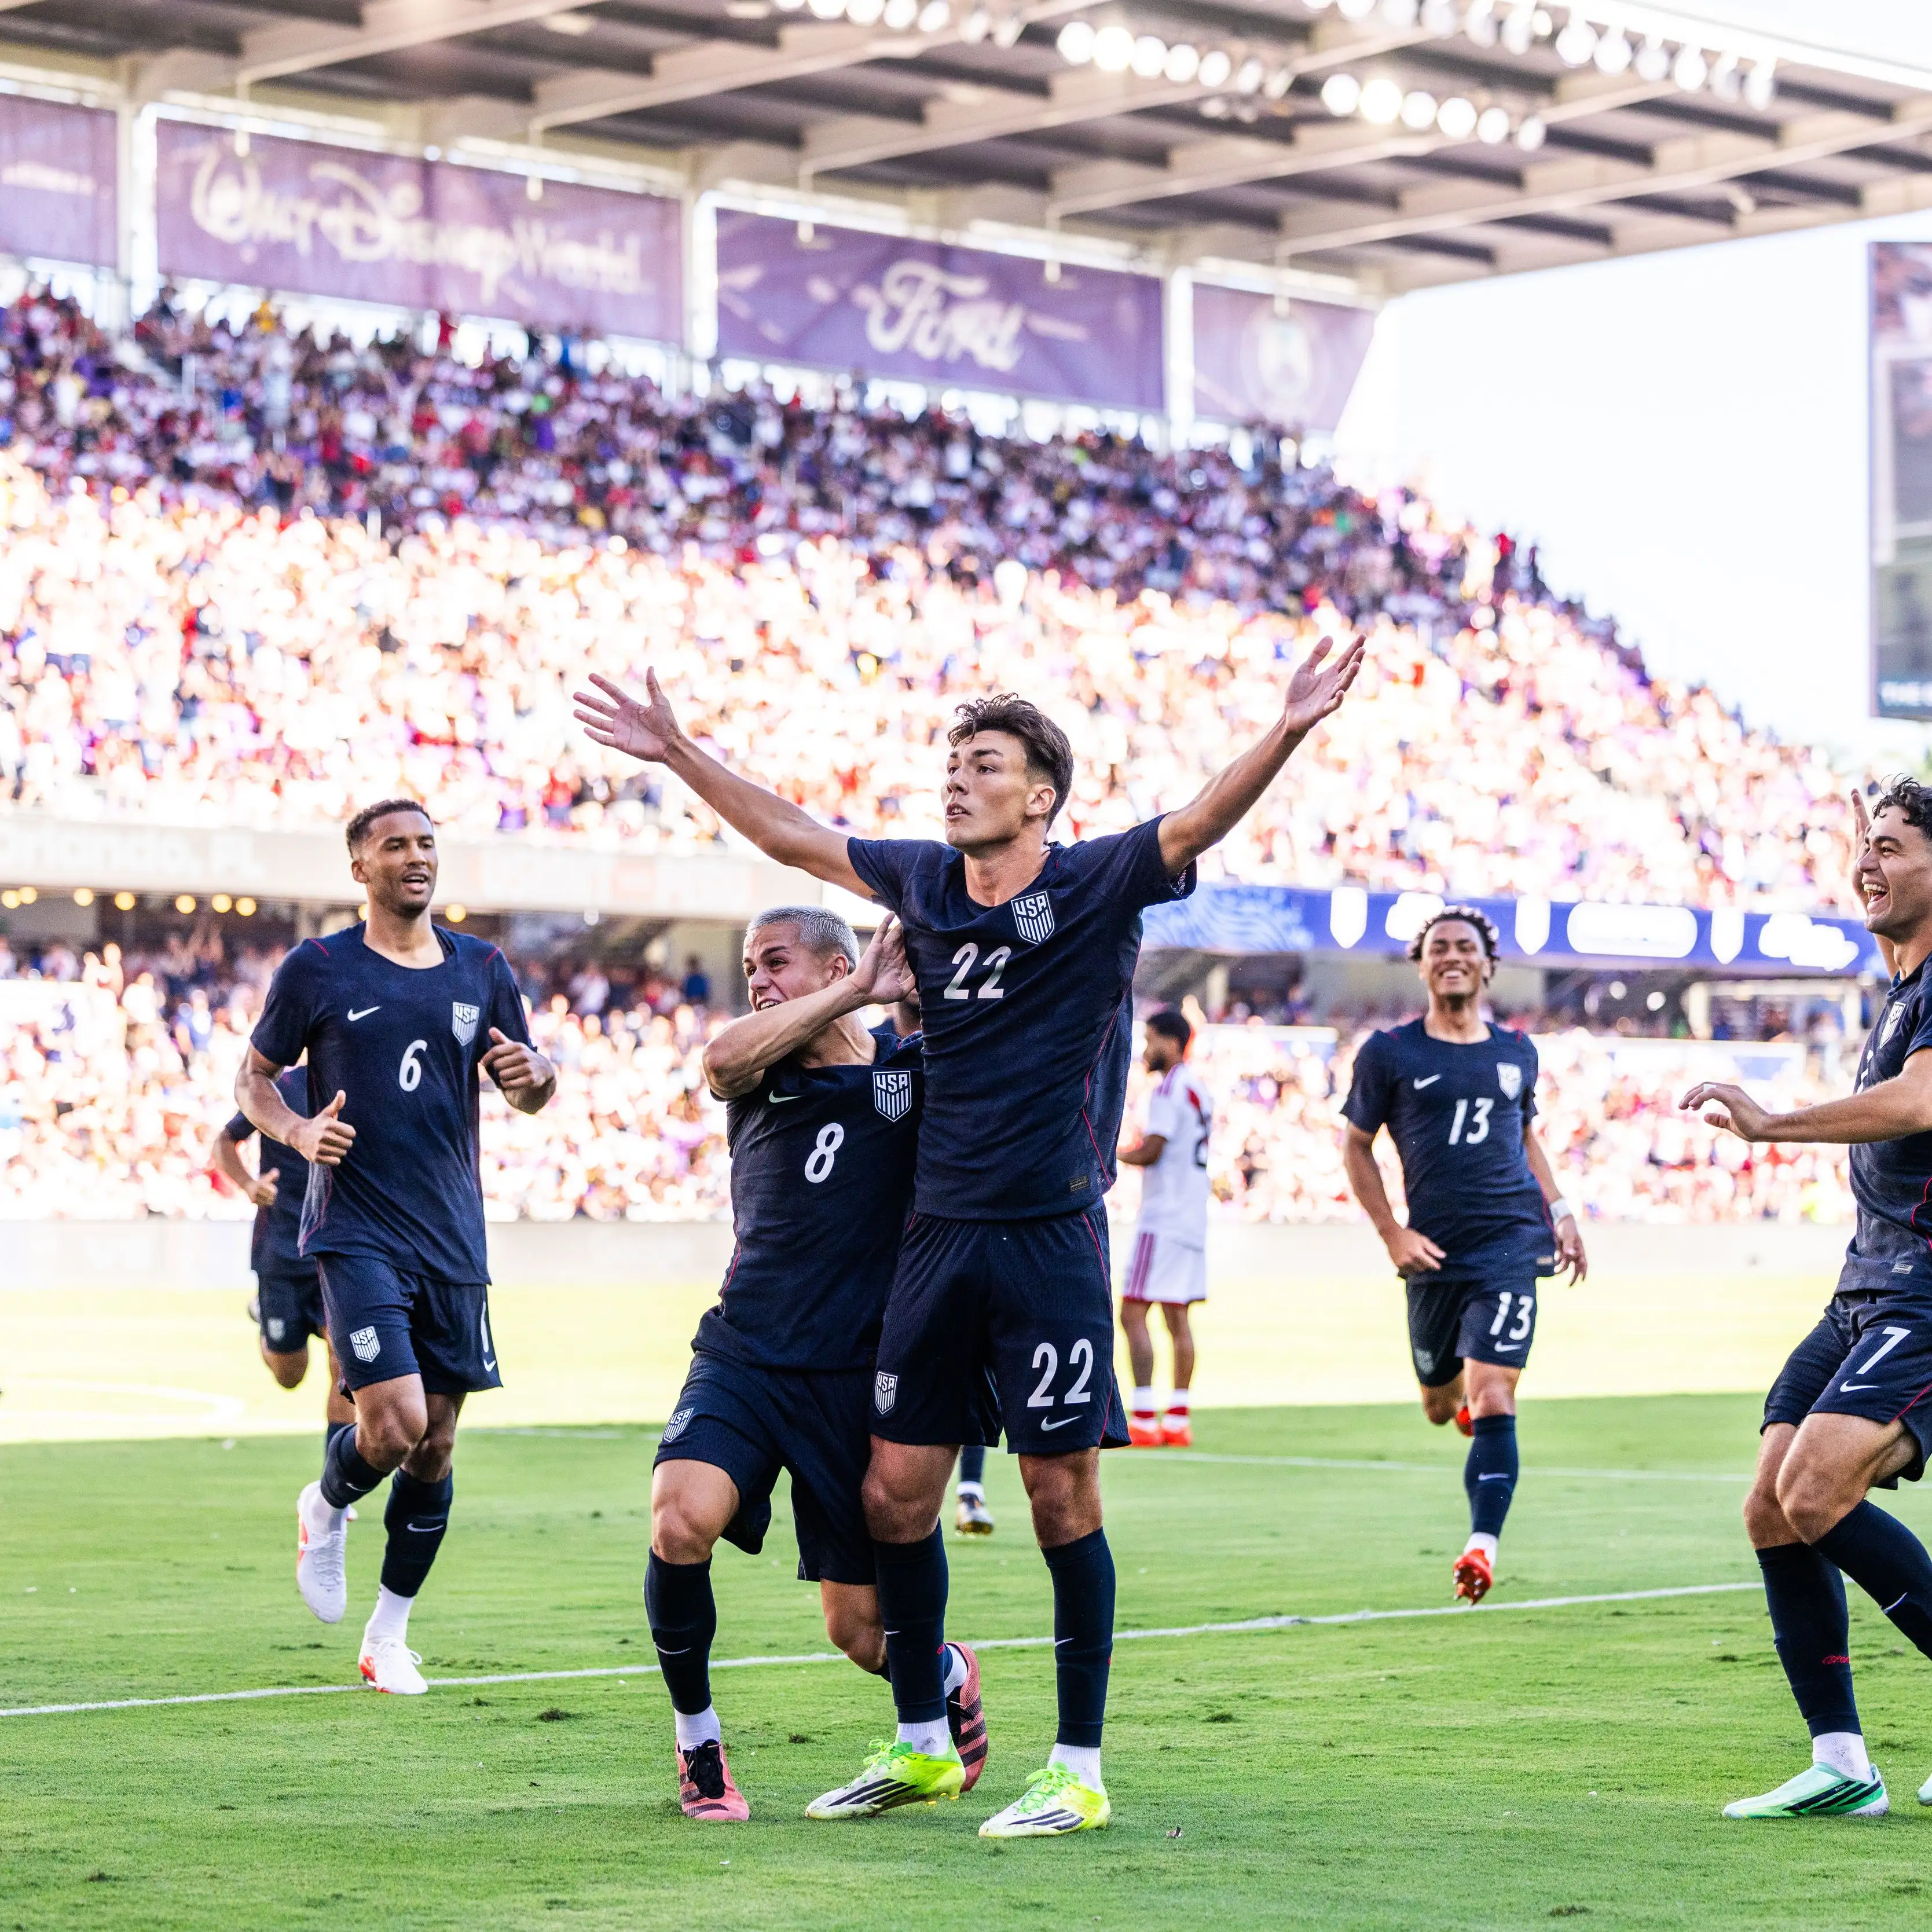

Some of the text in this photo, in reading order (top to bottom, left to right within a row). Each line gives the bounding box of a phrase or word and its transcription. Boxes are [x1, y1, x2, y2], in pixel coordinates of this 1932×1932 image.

[867, 262, 1023, 371] Ford
[1014, 895, 1047, 917] USA
[944, 943, 1011, 999] 22
[455, 1005, 478, 1024] USA
[399, 1039, 428, 1092] 6
[876, 1074, 908, 1093] USA
[1449, 1097, 1494, 1145] 13
[805, 1123, 844, 1183] 8
[353, 1329, 374, 1344] USA
[1489, 1292, 1534, 1340] 13
[1027, 1339, 1093, 1407] 22
[1856, 1326, 1912, 1374] 7
[878, 1374, 894, 1391] USA
[670, 1410, 691, 1424] USA
